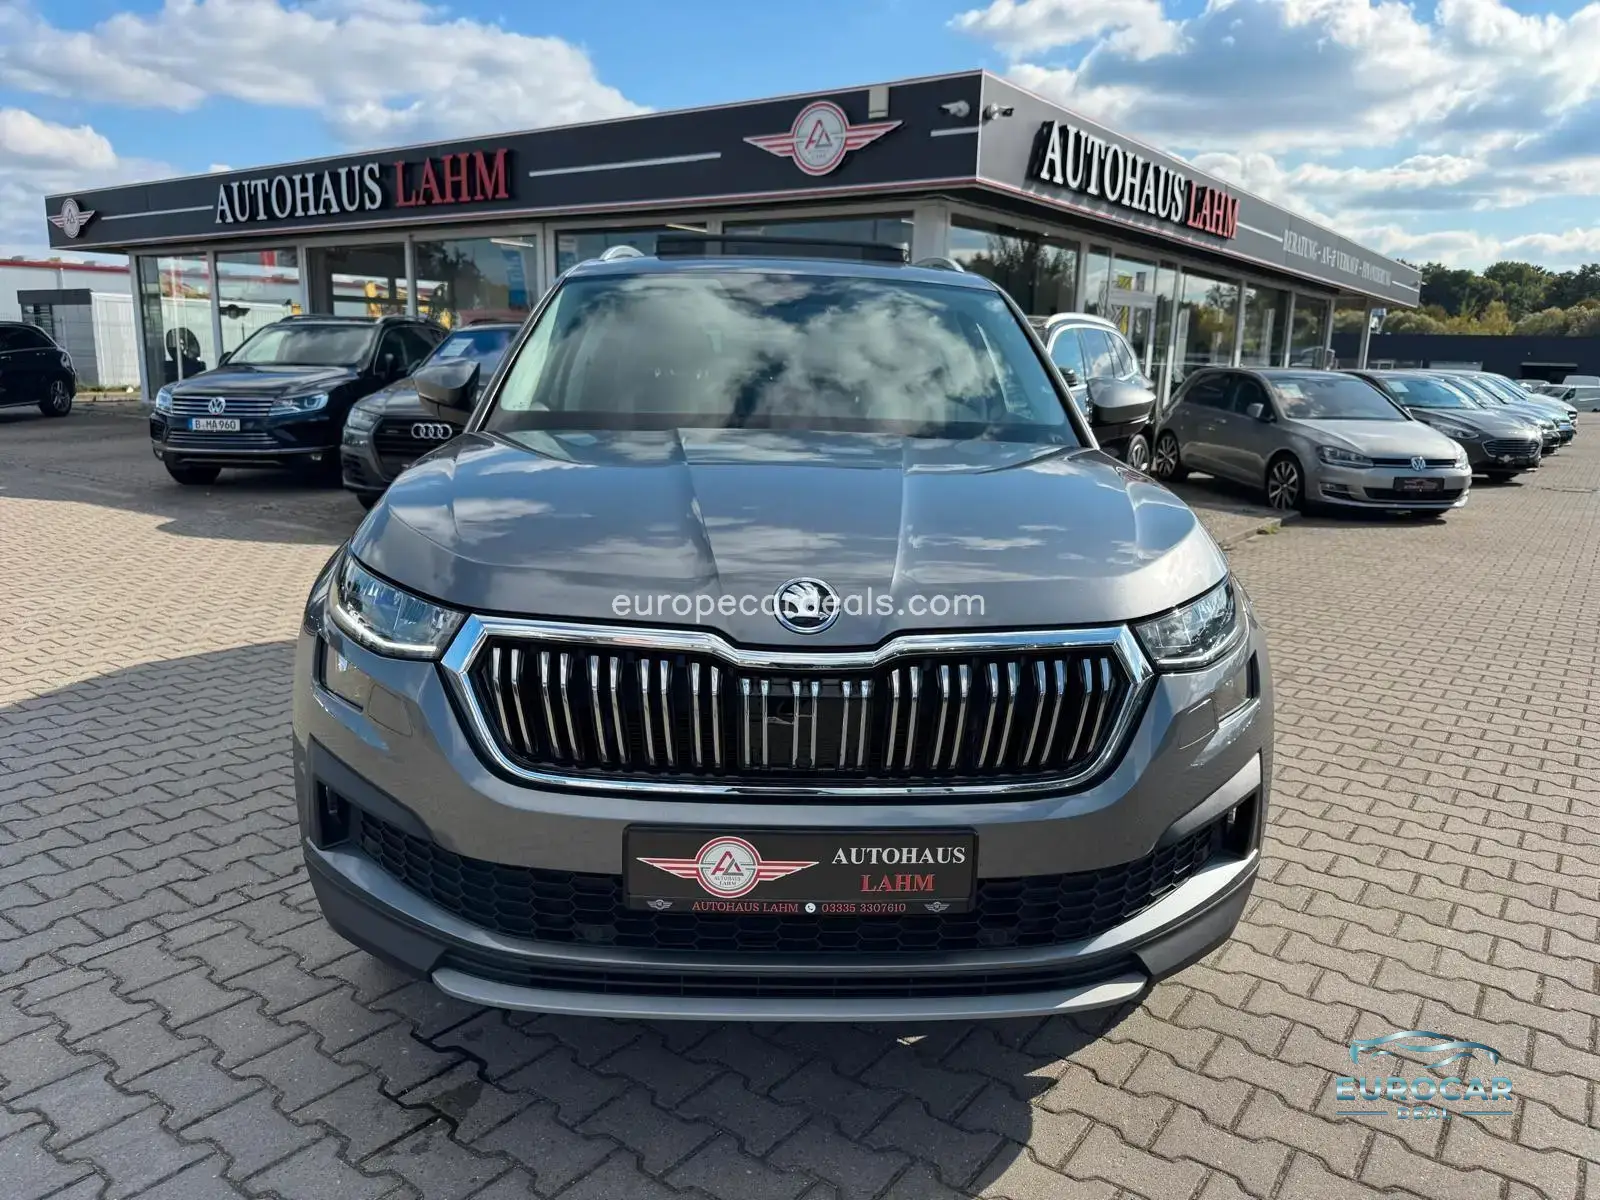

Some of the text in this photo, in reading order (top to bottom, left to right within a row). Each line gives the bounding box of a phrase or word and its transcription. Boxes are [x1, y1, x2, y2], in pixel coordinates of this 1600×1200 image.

[215, 148, 509, 225] AUTOHAUS LAHM
[1040, 120, 1241, 240] AUTOHAUS LAHM
[831, 847, 967, 864] AUTOHAUS
[860, 873, 936, 892] LAHM
[692, 901, 907, 913] AUTOHAUS LAHM 03335 3307610
